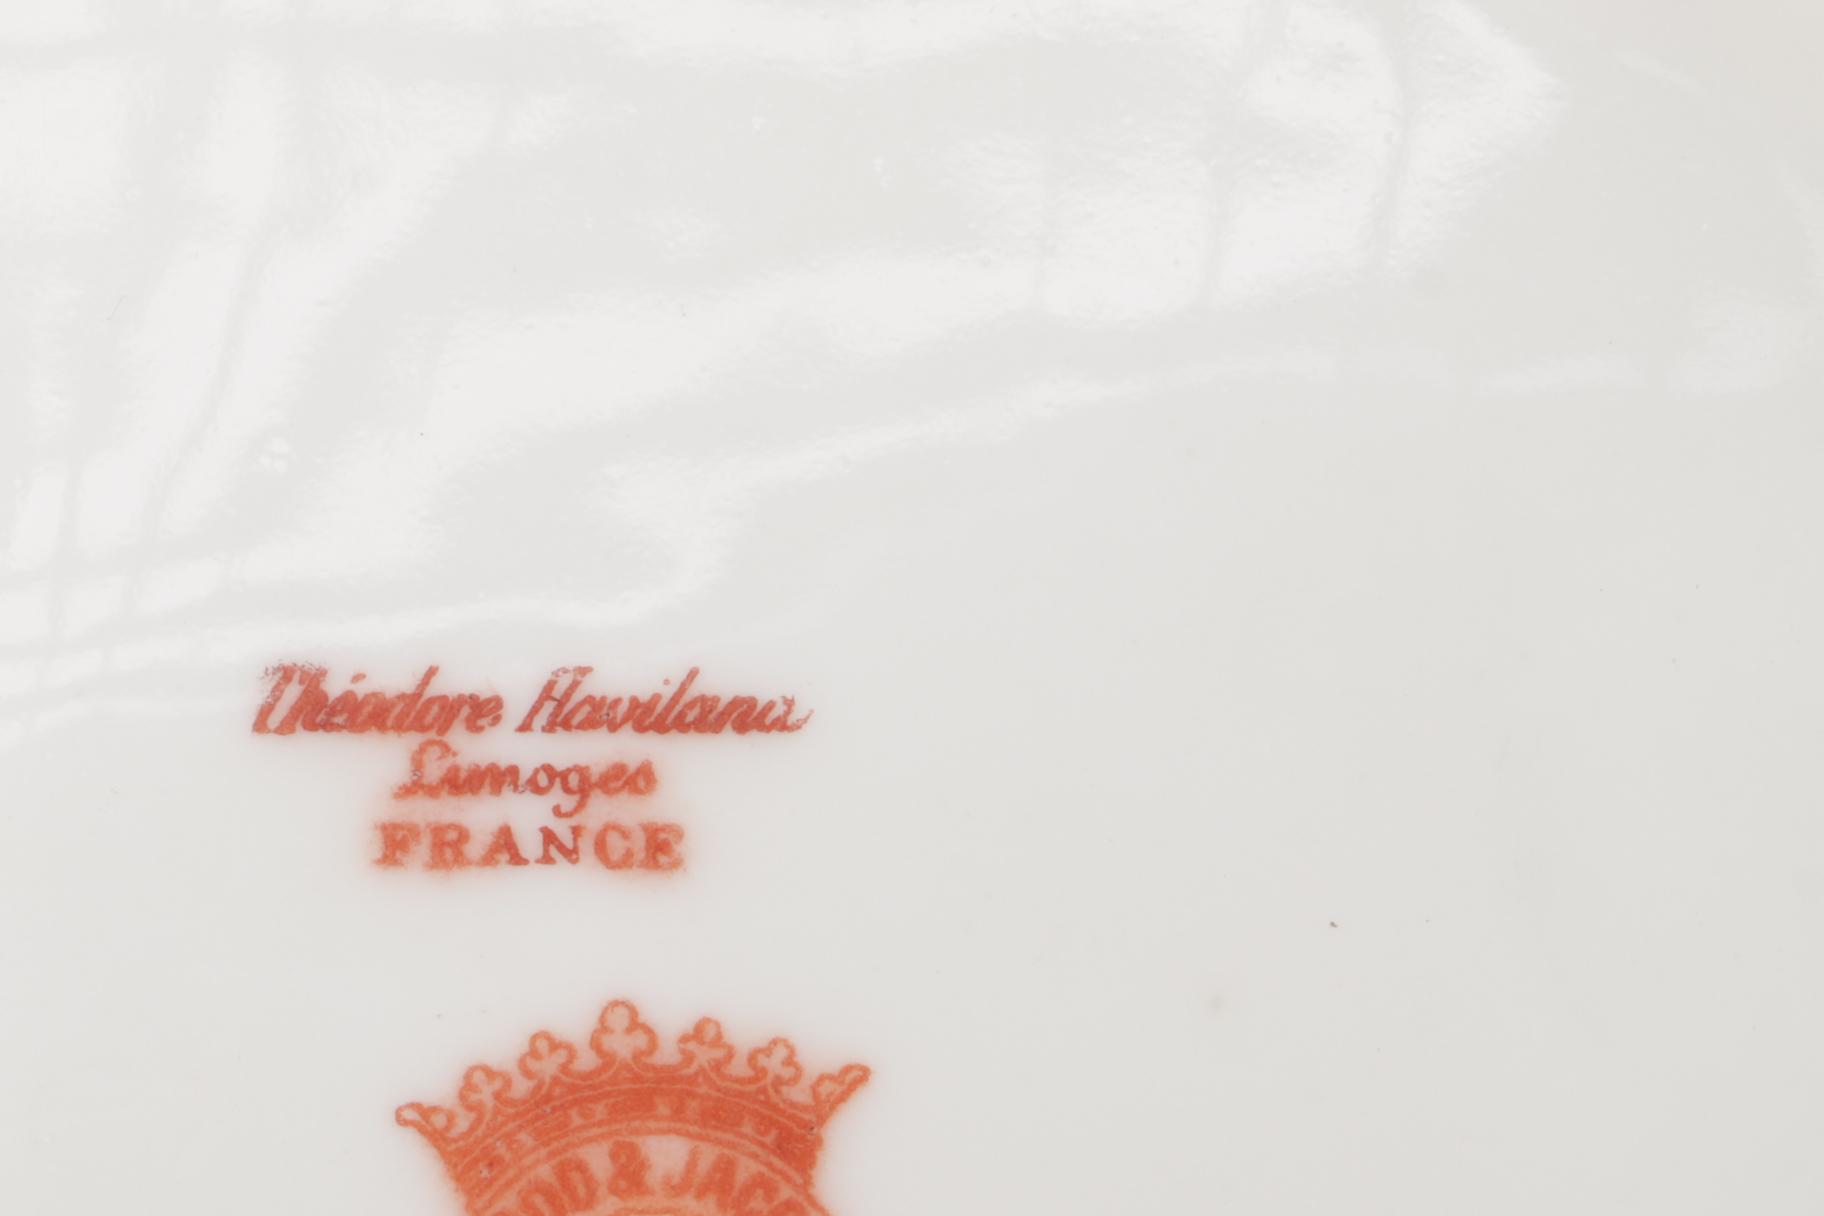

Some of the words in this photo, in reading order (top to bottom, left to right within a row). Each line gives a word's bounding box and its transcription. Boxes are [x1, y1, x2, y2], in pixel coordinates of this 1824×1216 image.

[392, 738, 659, 818] Limoges
[373, 821, 686, 872] FRANCE
[607, 1138, 653, 1199] &
